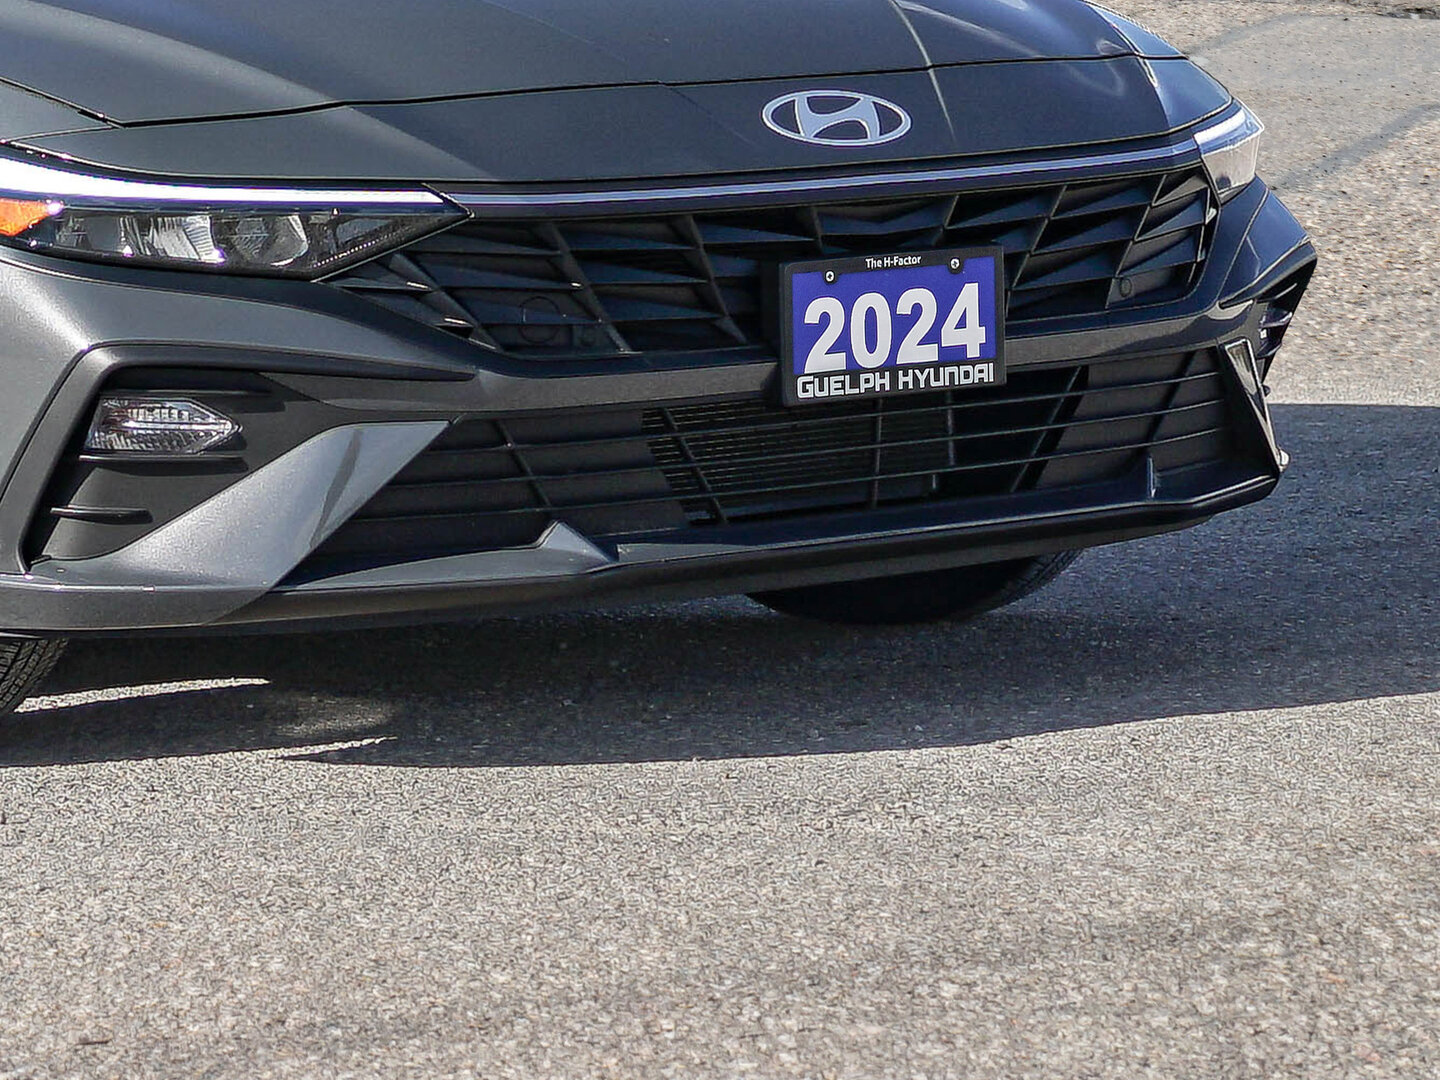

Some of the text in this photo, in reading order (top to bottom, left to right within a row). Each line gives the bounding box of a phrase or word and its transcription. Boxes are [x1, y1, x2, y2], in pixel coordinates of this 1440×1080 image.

[865, 254, 922, 269] The H-Factor
[803, 282, 987, 374] 2024
[796, 362, 995, 399] GUELPH HYUNDAI
